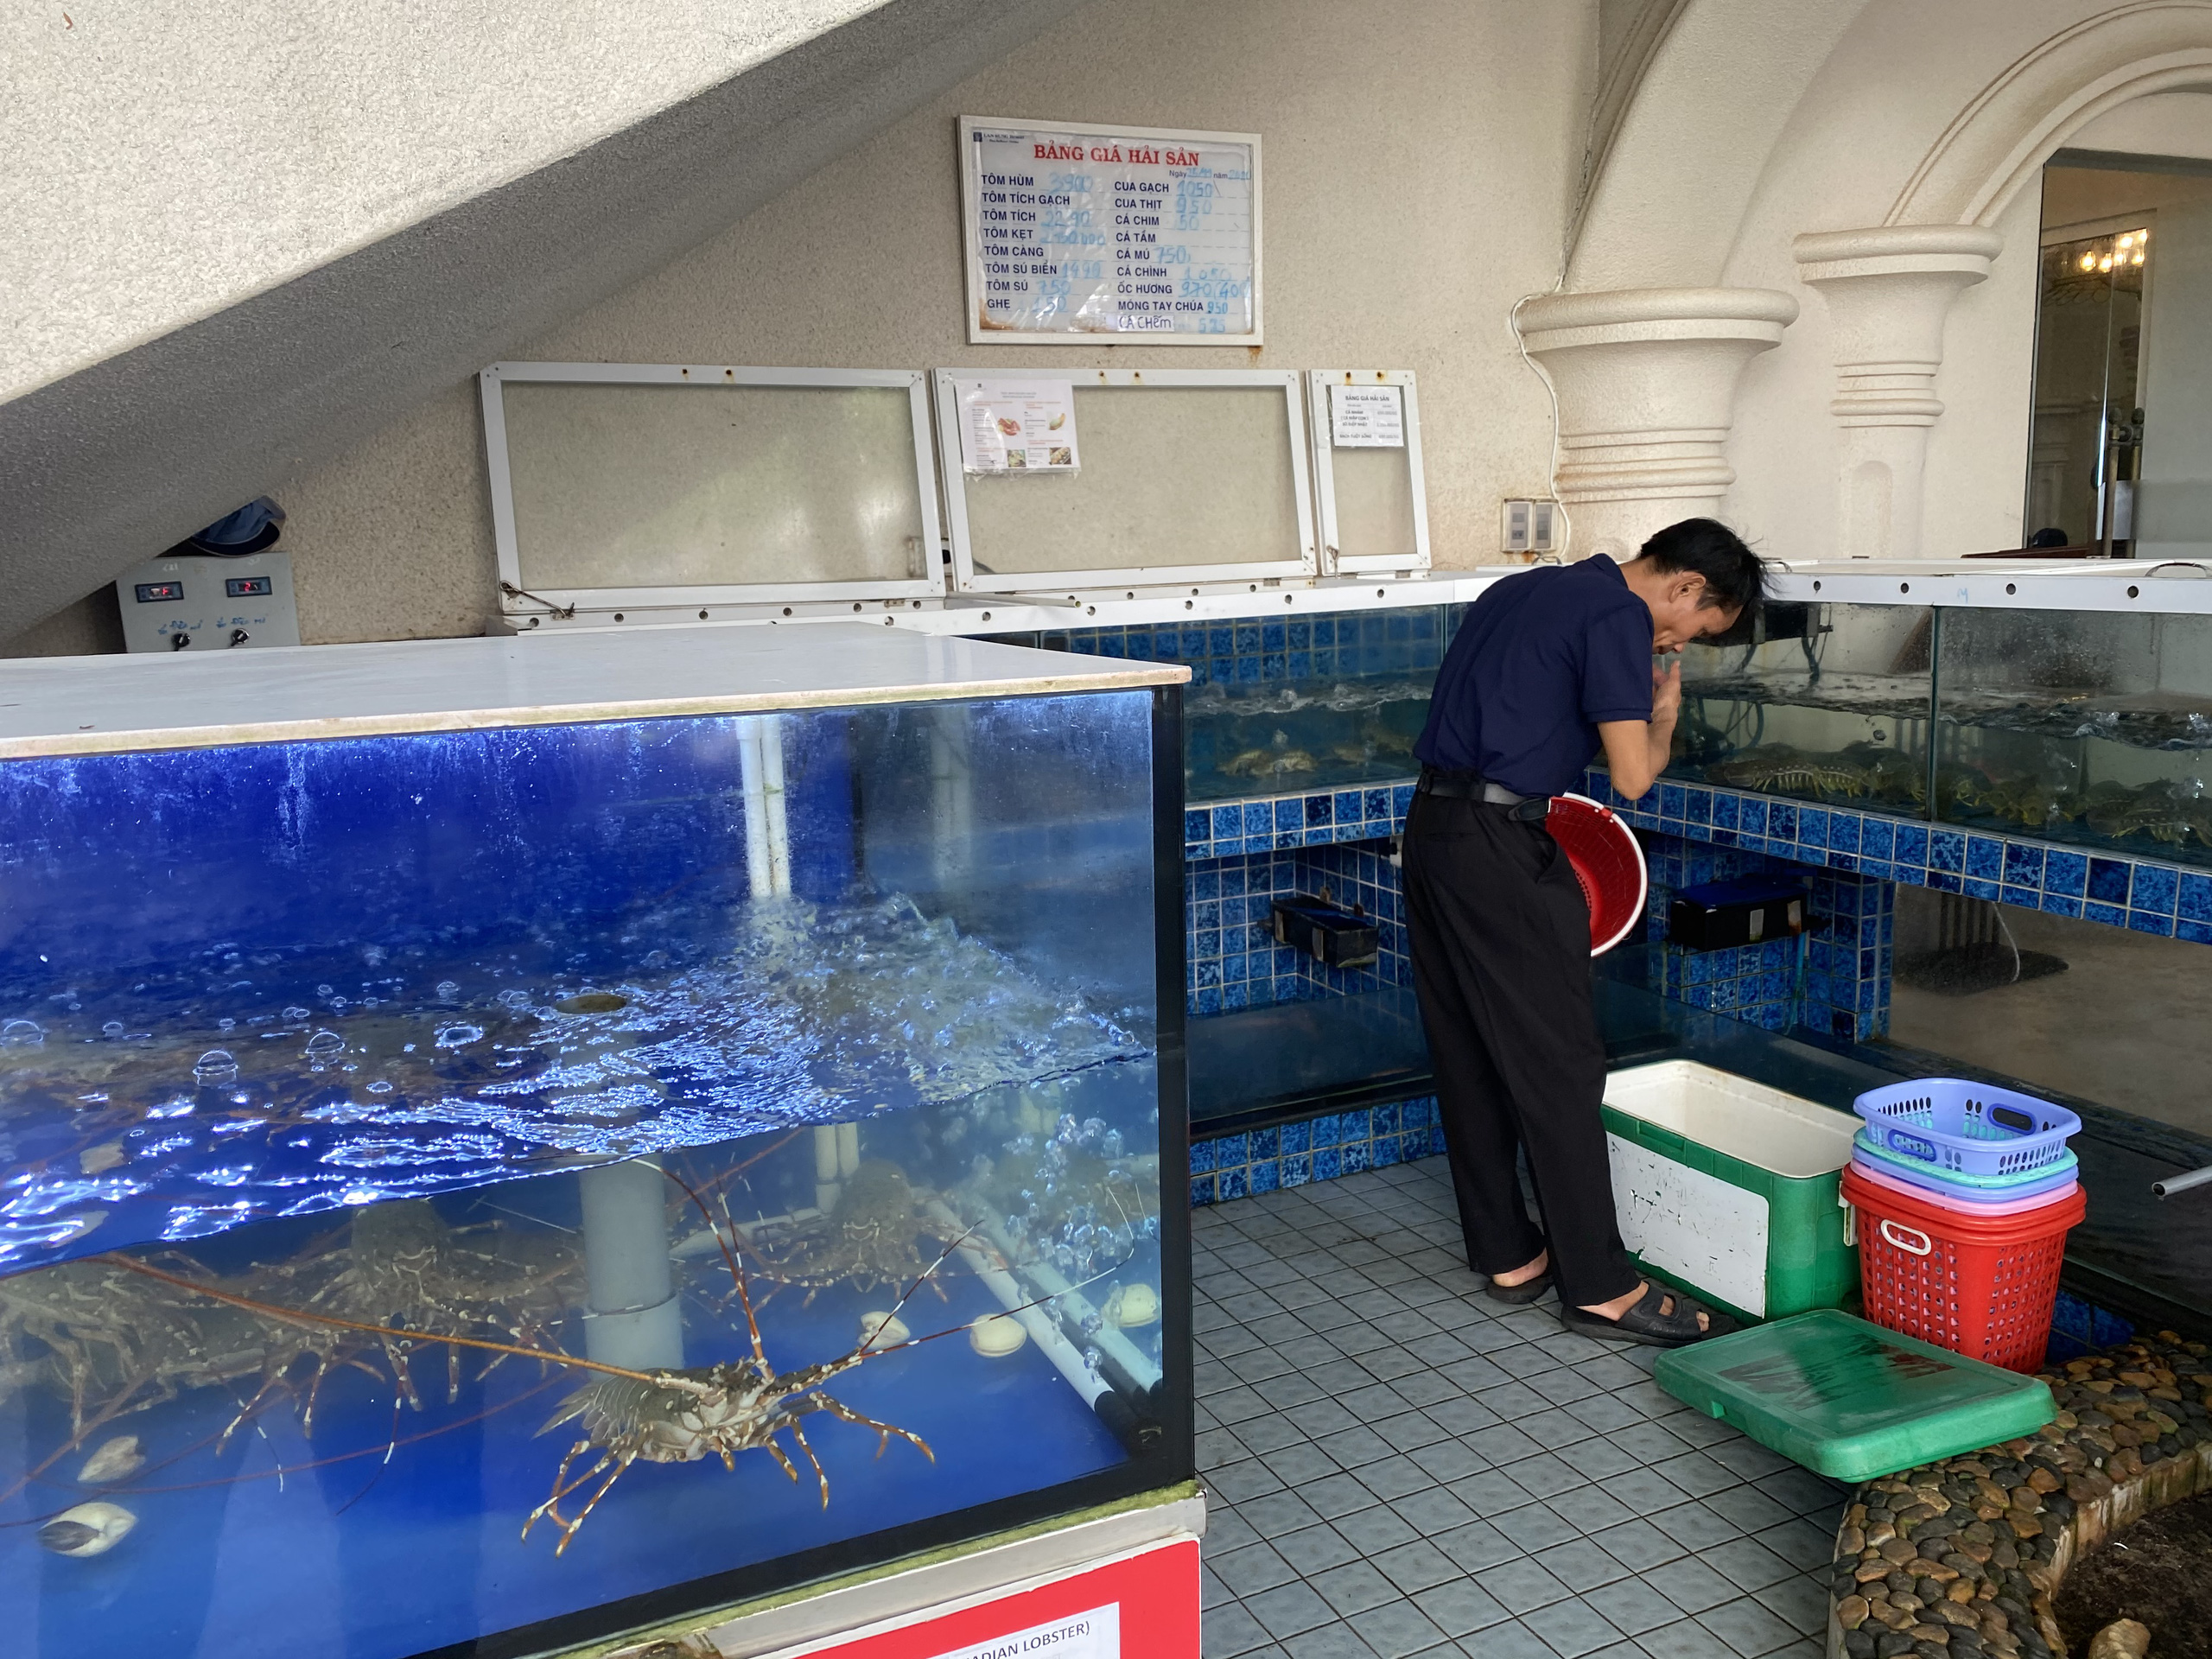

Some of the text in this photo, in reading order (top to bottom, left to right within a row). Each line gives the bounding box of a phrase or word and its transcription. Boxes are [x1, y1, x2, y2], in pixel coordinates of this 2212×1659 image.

[1033, 140, 1199, 166] BẢNG GIÁ HẢI SẢN
[982, 173, 1005, 185] TÔM
[1009, 174, 1034, 186] HÙM
[1115, 181, 1136, 192] CUA
[1139, 182, 1169, 194] GẠCH
[982, 190, 1071, 207] TÔM TÍCH GẠCH
[1115, 199, 1136, 208] CUA
[1140, 199, 1162, 211] THỊT
[983, 208, 1007, 221] TÔM
[1011, 209, 1036, 221] TÍCH
[1116, 213, 1130, 225] CÁ
[1134, 215, 1160, 226] CHIM
[983, 226, 1007, 238] TÔM
[1012, 229, 1033, 241] KẸT
[1116, 230, 1130, 242] CÁ
[984, 244, 1044, 257] TÔM CÀNG
[1116, 247, 1131, 259] CÁ
[1135, 248, 1150, 259] MÚ
[985, 262, 1009, 274] TÔM
[1013, 262, 1027, 274] SÚ
[1032, 260, 1057, 274] BIỂN
[1117, 264, 1131, 276] CÁ
[1135, 265, 1166, 276] CHÌNH
[987, 278, 1010, 291] TÔM
[1014, 279, 1028, 291] SÚ
[1117, 281, 1132, 294] ỐC
[1135, 283, 1173, 294] HƯƠNG
[988, 299, 1010, 310] GHẸ
[1118, 300, 1149, 310] MÓNG
[1153, 302, 1173, 311] TAY
[1175, 300, 1204, 311] CHÚA
[1119, 315, 1135, 330] CÁ
[1023, 1621, 1090, 1652] LOBSTER)
